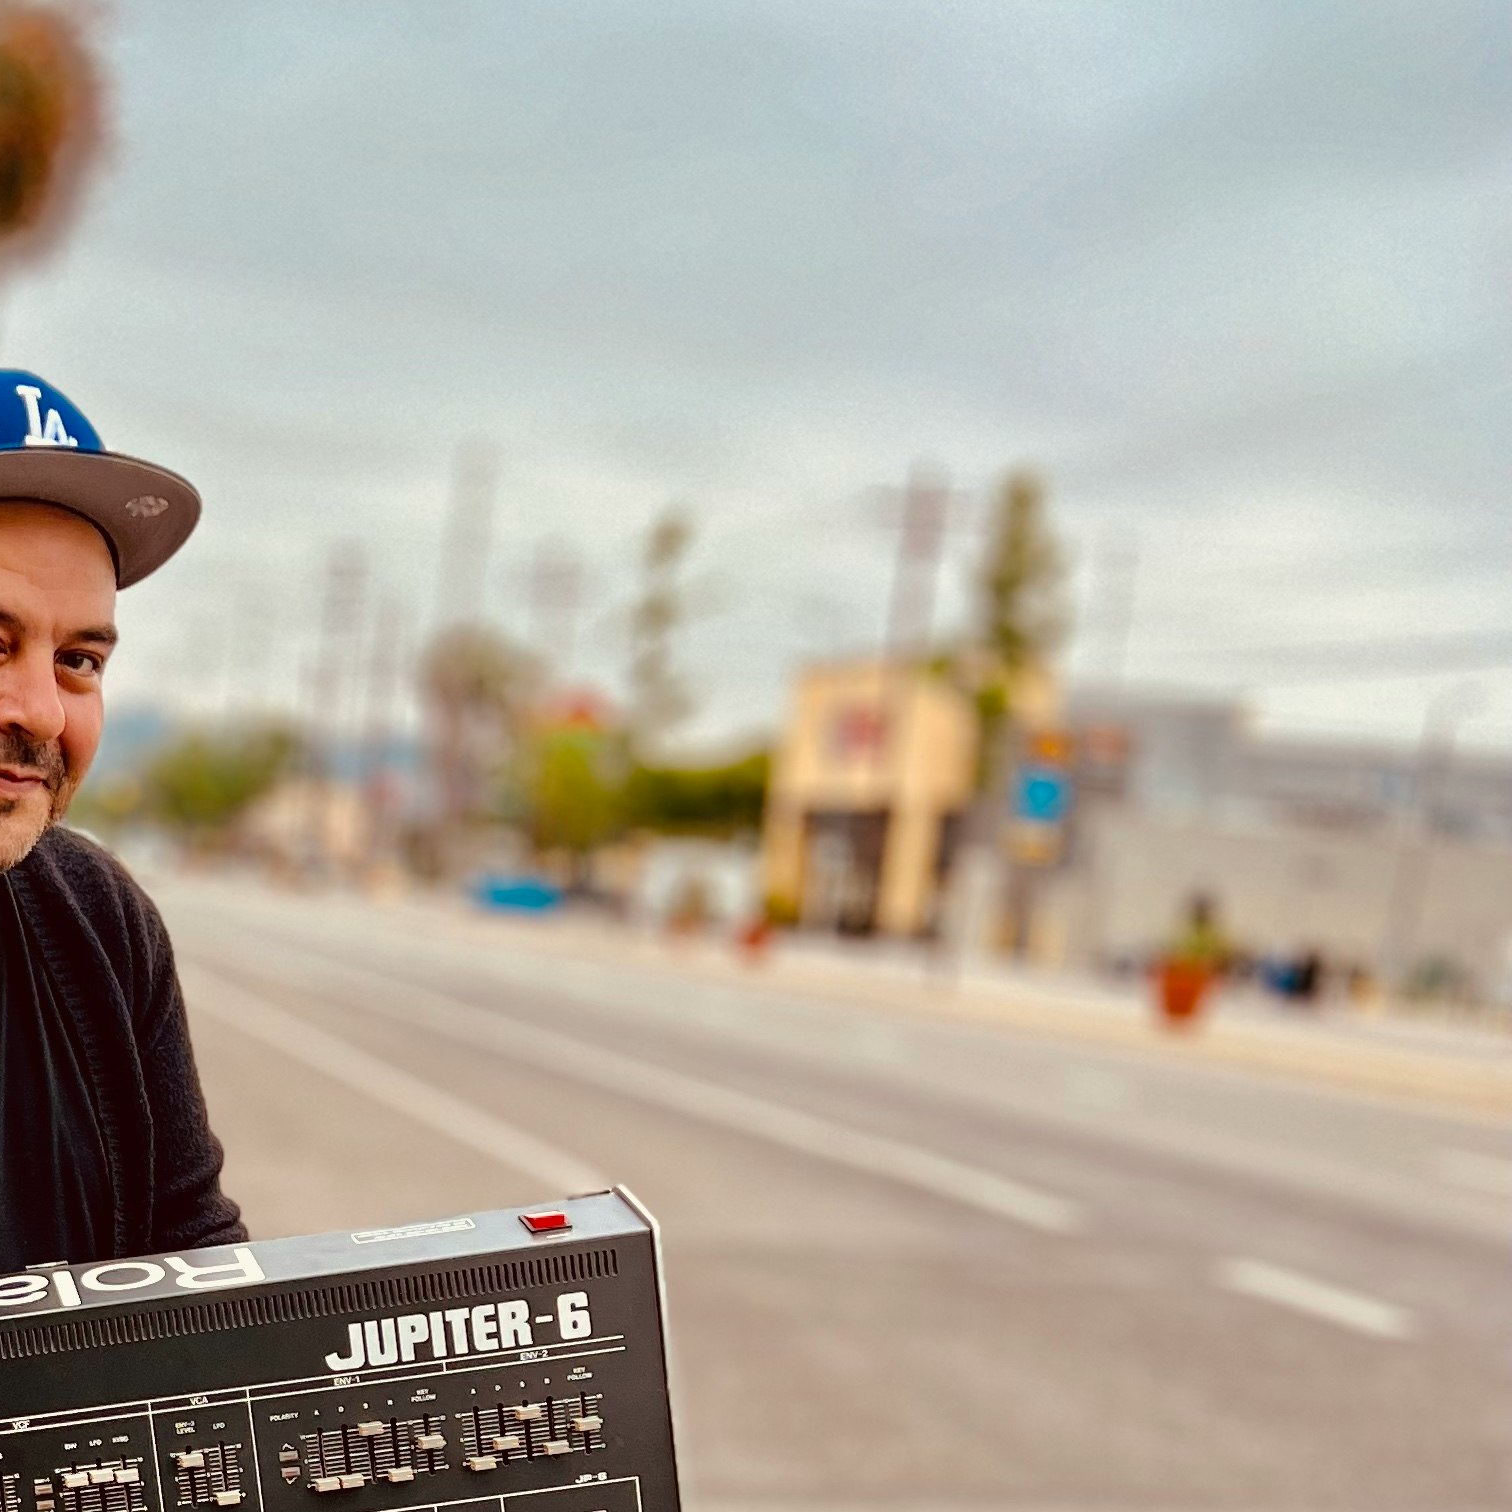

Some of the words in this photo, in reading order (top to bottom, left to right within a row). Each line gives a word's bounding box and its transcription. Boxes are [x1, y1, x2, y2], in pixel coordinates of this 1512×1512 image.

[16, 384, 78, 447] LA
[324, 1291, 592, 1371] JUPITER-6
[520, 1350, 549, 1361] ENV-2
[334, 1376, 361, 1386] ENV-1
[190, 1396, 209, 1405] VCA
[269, 1412, 299, 1423] POLARITY
[12, 1419, 31, 1430] VCF
